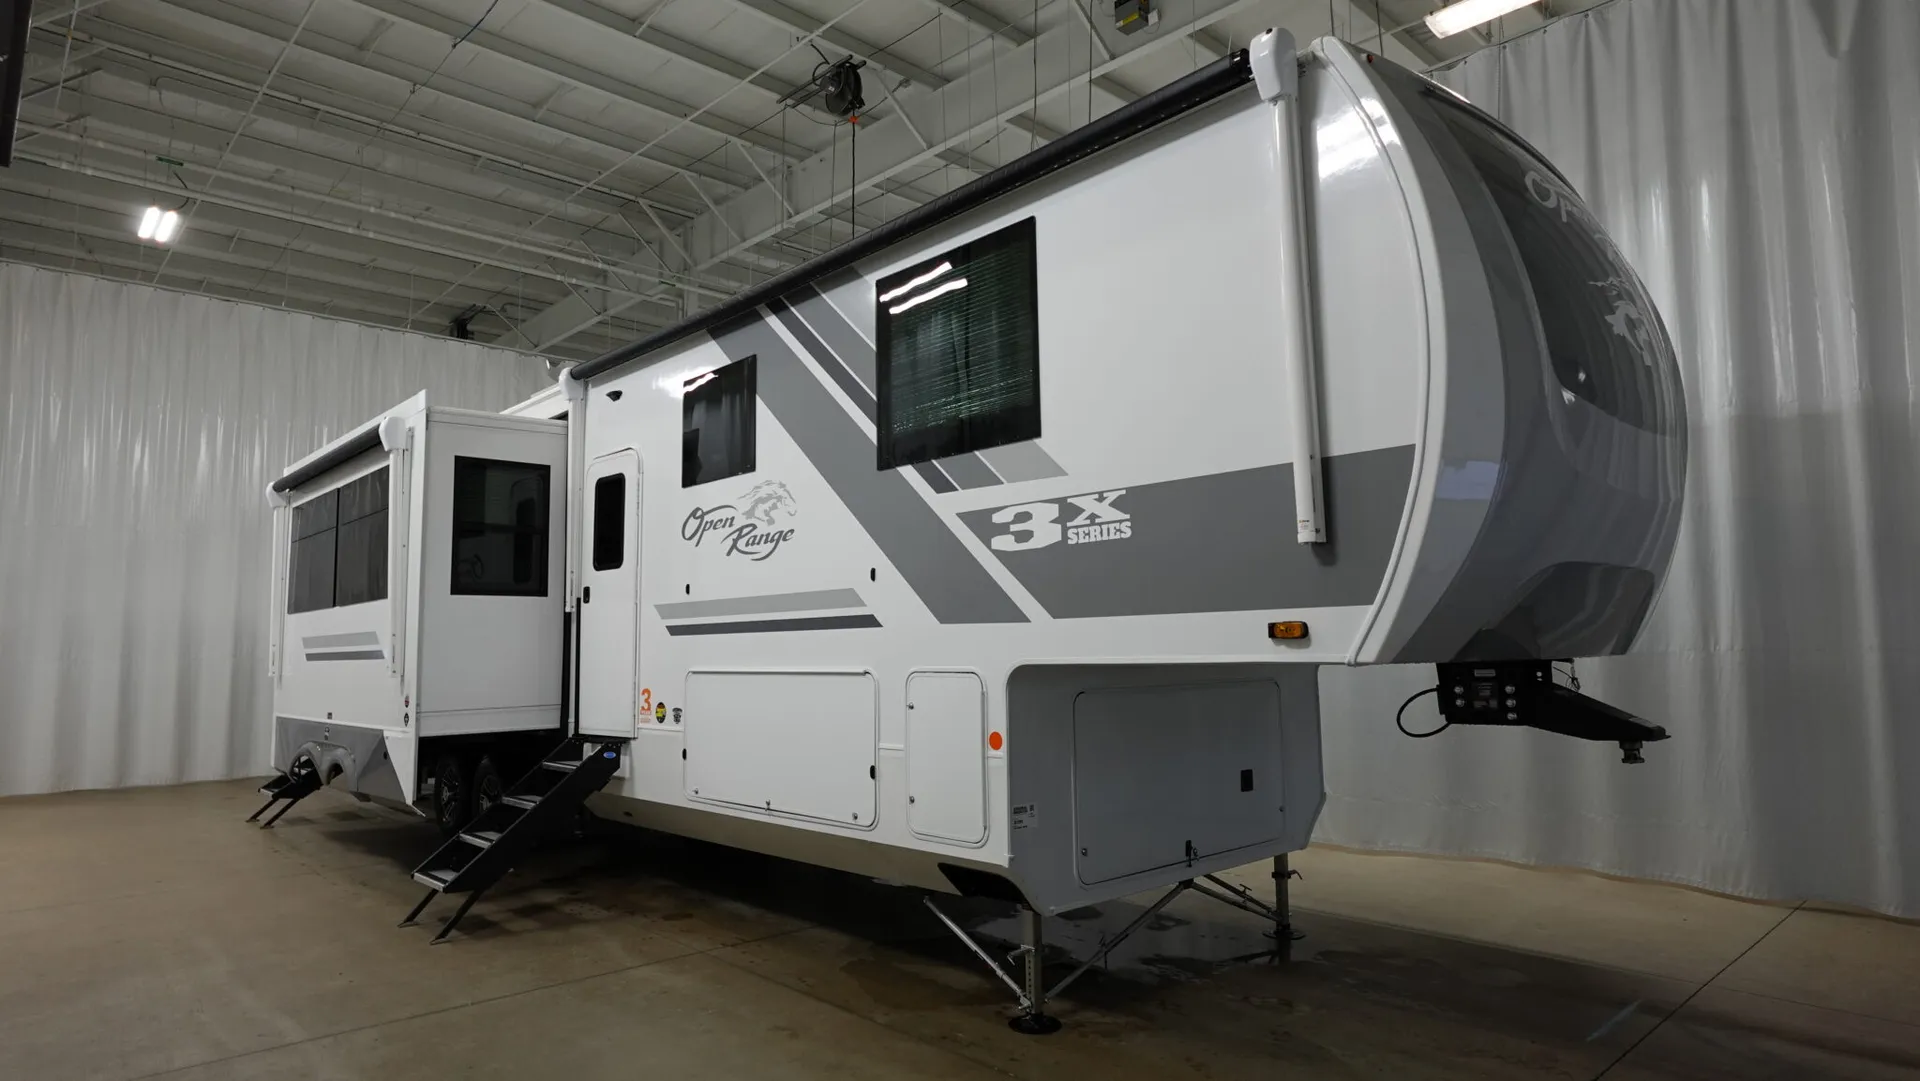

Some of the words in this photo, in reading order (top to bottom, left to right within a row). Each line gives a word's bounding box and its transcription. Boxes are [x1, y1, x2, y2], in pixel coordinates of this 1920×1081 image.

[681, 504, 739, 547] Open
[1067, 521, 1132, 545] SERIES
[720, 523, 795, 561] Range
[640, 688, 652, 711] 3
